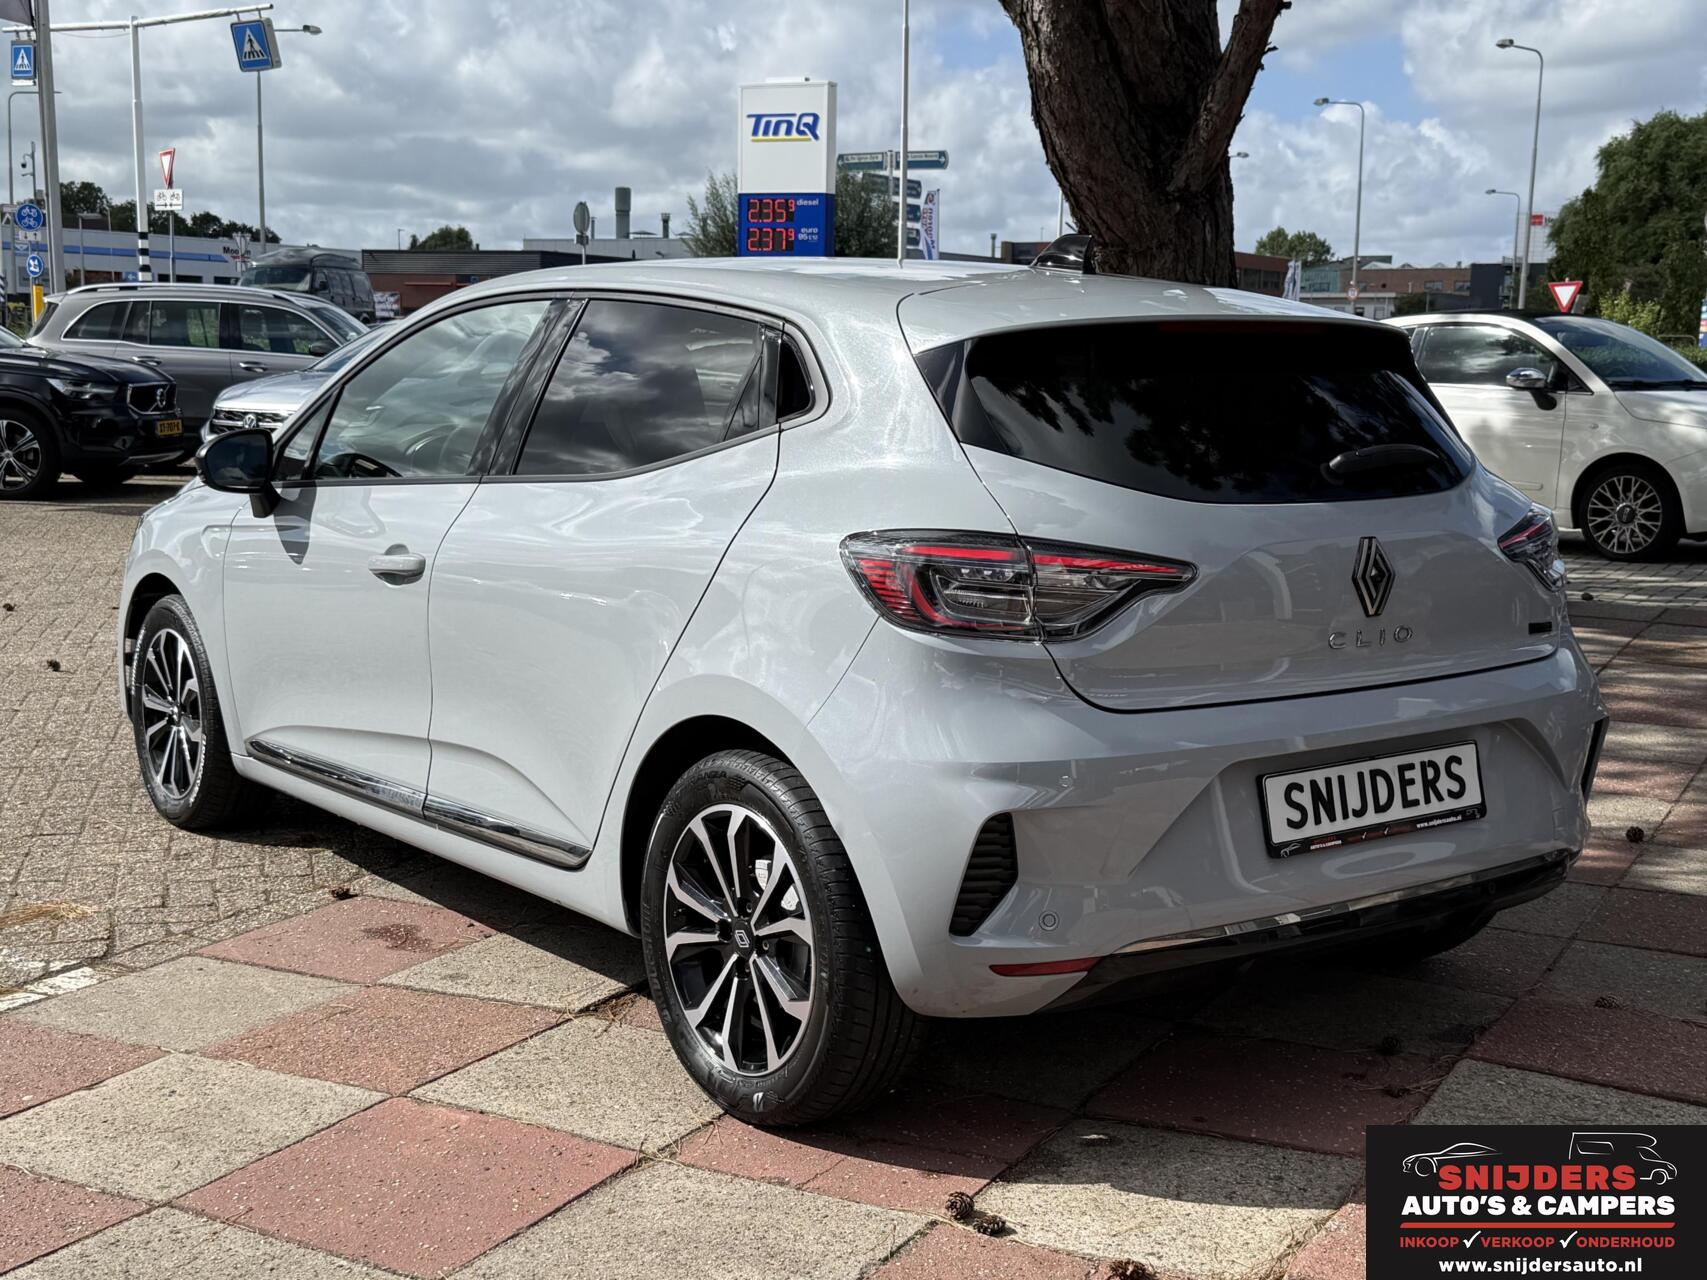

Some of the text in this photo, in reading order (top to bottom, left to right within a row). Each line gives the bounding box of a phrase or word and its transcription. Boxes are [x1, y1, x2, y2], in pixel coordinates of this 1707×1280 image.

[796, 198, 819, 206] diesel
[1327, 625, 1413, 649] CLIO
[1283, 755, 1467, 830] SNIJDERS
